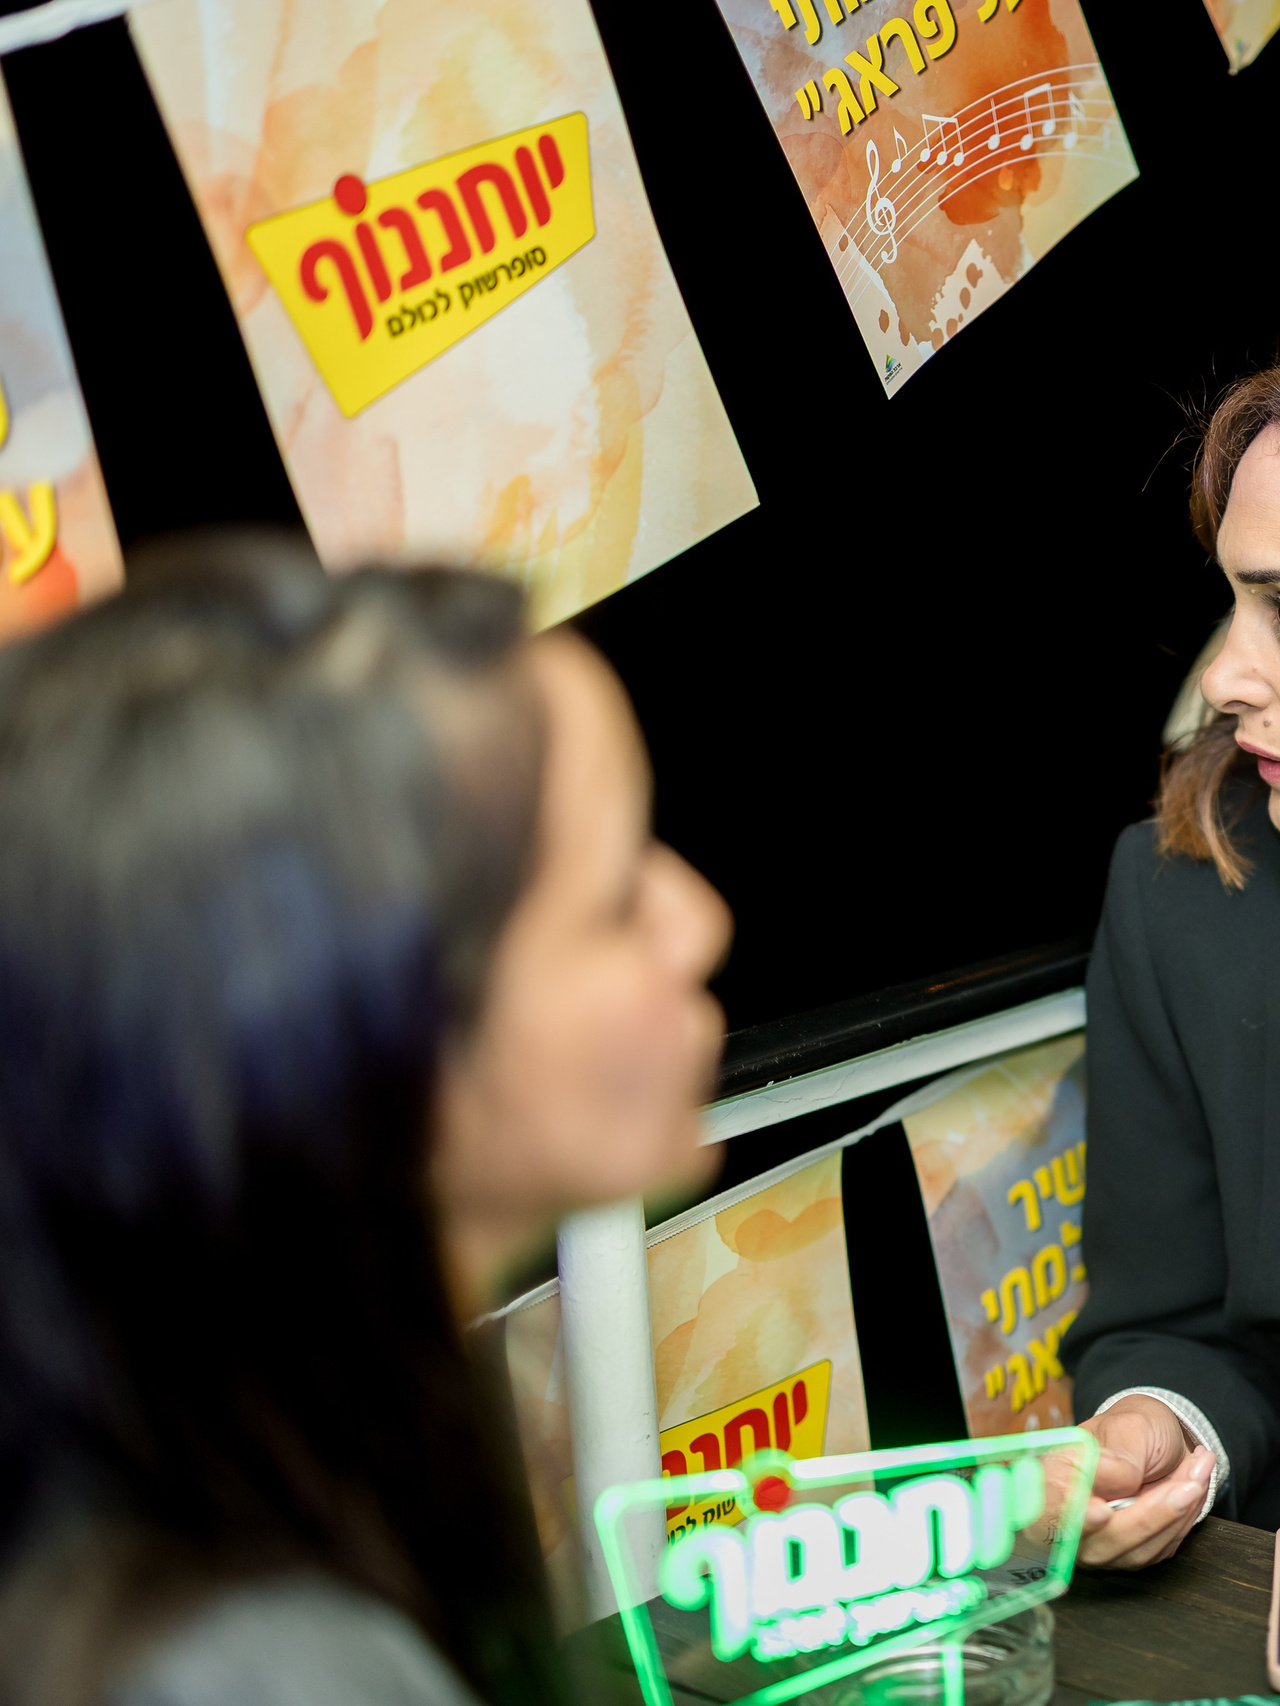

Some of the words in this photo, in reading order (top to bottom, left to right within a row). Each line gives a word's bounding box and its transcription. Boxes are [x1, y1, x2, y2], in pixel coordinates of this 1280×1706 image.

[298, 133, 565, 342] יוחננוף
[458, 245, 548, 310] סופרשוק
[385, 290, 451, 339] לכולם
